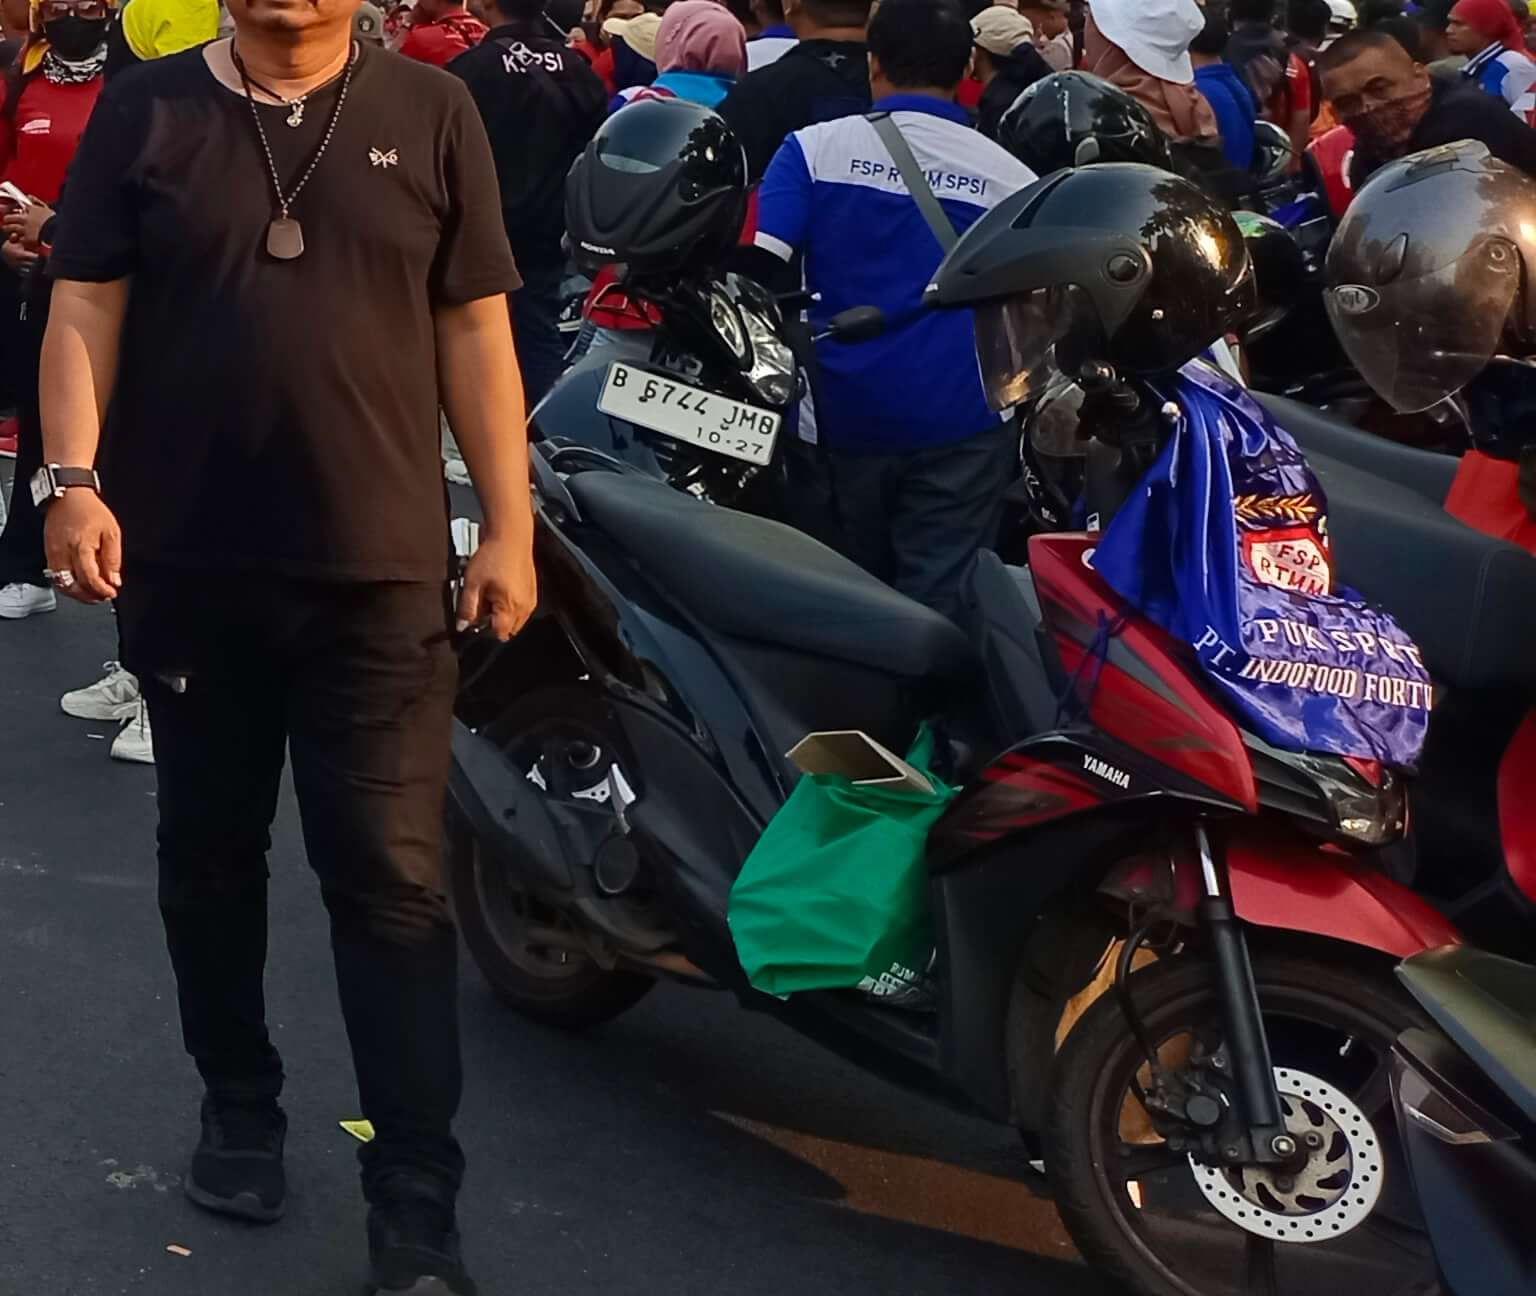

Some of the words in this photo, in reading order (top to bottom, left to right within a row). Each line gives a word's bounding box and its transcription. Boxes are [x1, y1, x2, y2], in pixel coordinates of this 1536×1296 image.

[850, 159, 885, 177] FSP
[946, 174, 988, 196] SPSI
[612, 368, 628, 388] B
[1277, 544, 1321, 570] FSP
[1260, 556, 1325, 596] RTMM
[1254, 618, 1329, 651] PUK
[1192, 625, 1233, 672] PT.
[1237, 656, 1359, 699] INDOFOOD
[1083, 754, 1131, 790] YAMAHA
